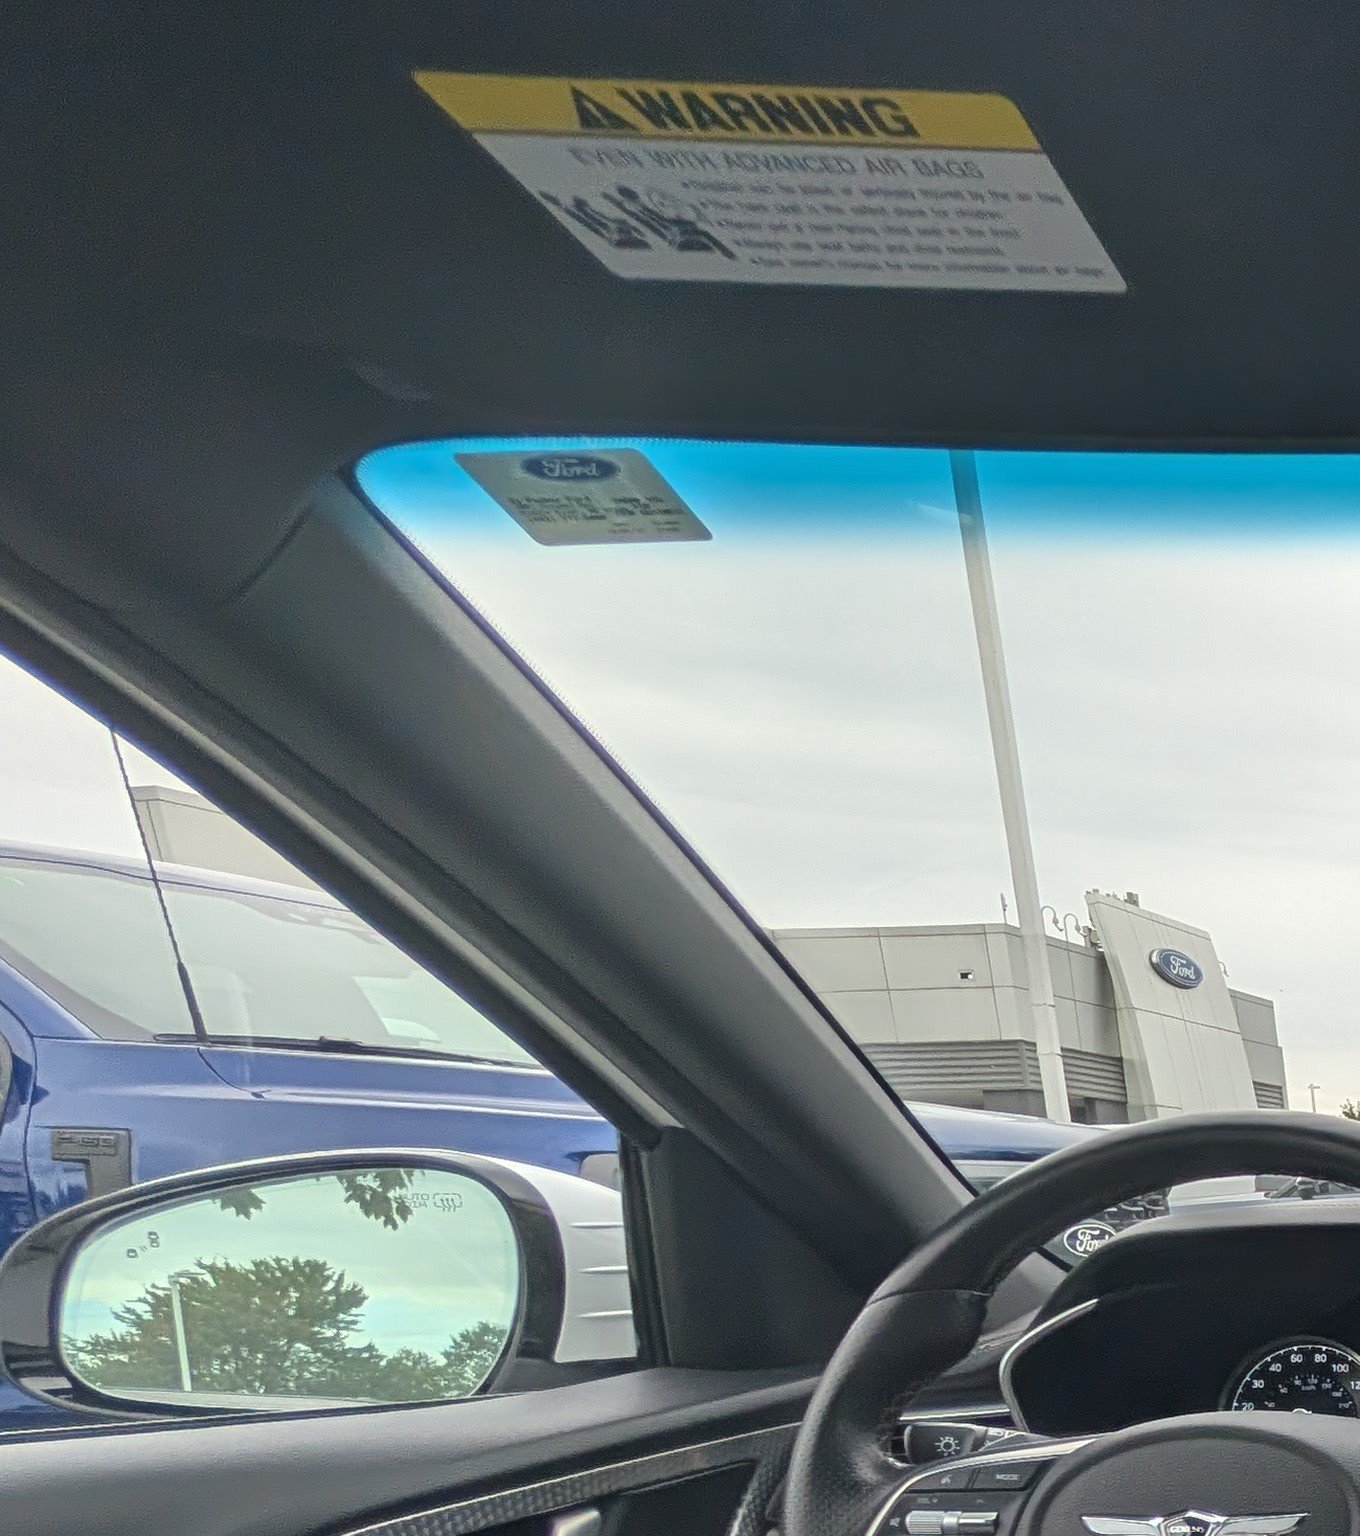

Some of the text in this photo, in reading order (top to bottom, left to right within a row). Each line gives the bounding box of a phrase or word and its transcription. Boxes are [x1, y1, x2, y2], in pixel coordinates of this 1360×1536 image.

[615, 86, 921, 139] WARNING
[863, 156, 909, 176] AIR
[540, 458, 599, 478] Ford
[1170, 955, 1196, 980] Ford
[1290, 1353, 1303, 1363] 60
[1314, 1353, 1327, 1363] 80
[1269, 1363, 1282, 1373] 40
[1332, 1363, 1349, 1373] 100
[1252, 1379, 1265, 1389] 30
[1242, 1402, 1255, 1411] 20
